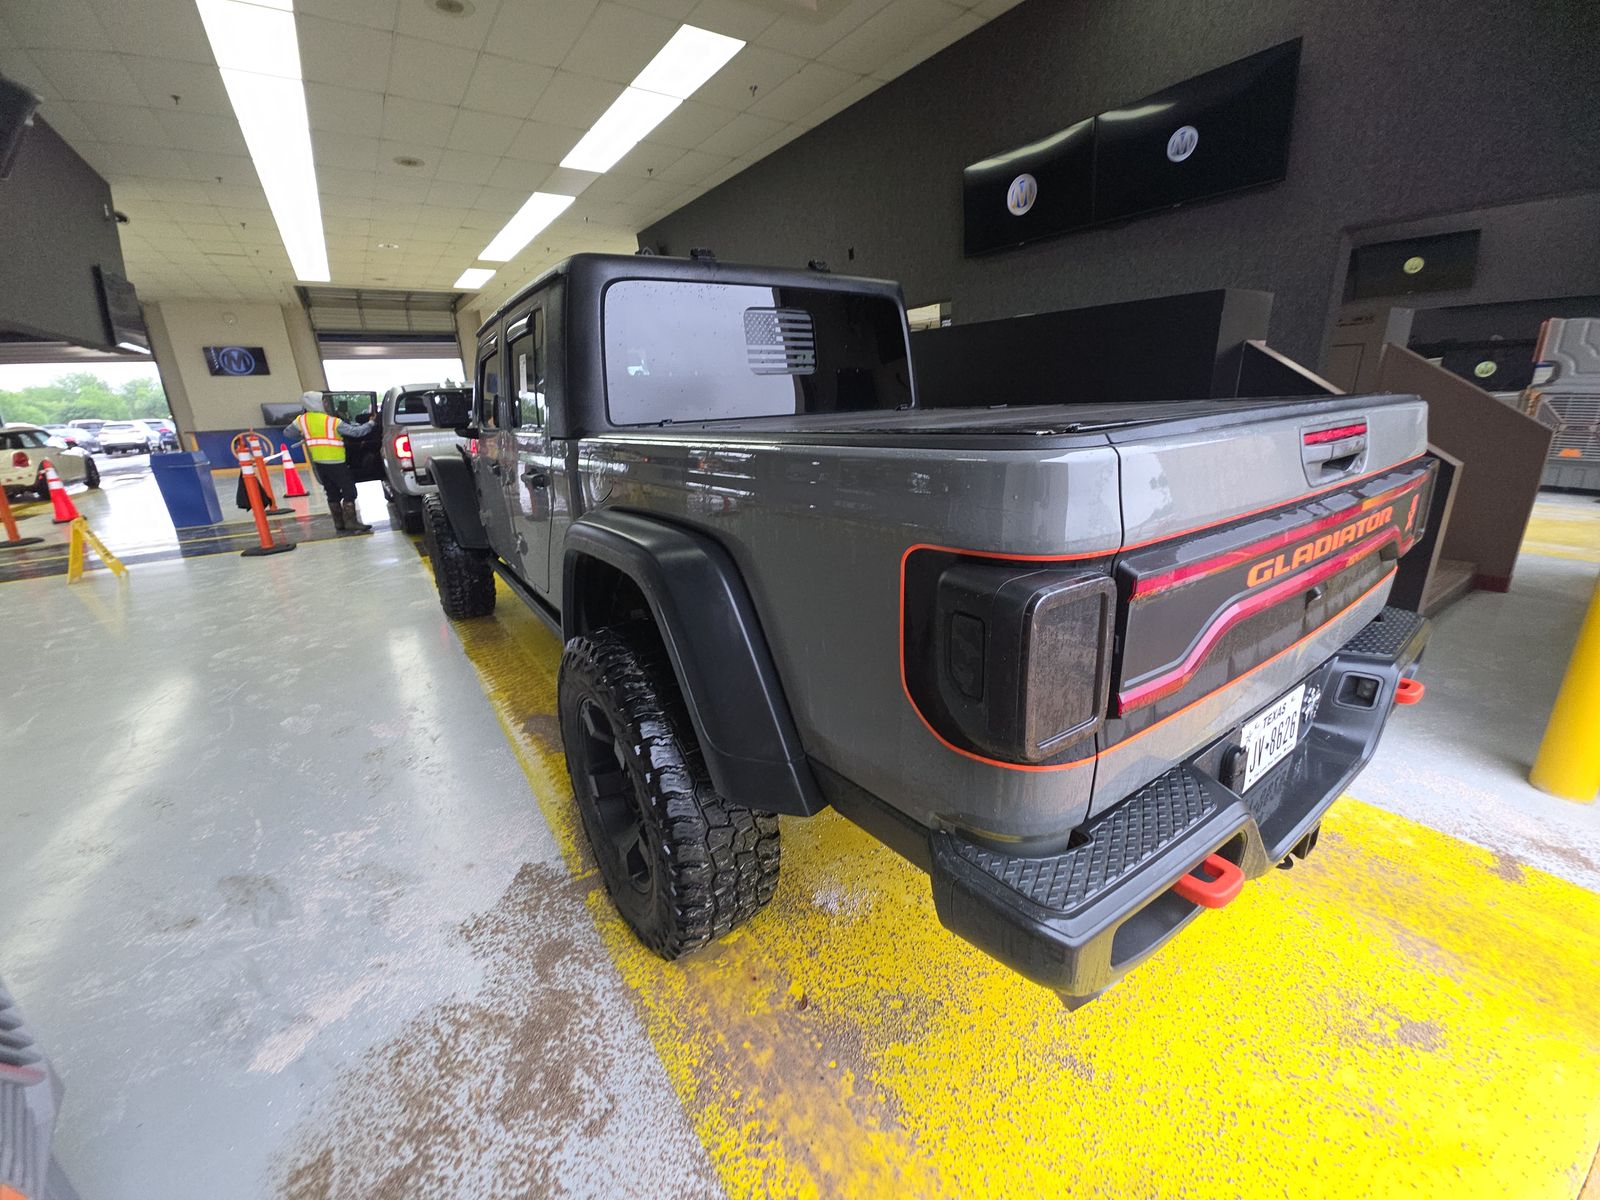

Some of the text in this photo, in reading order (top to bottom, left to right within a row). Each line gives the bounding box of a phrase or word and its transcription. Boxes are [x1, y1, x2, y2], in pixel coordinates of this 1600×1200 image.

[222, 349, 253, 373] M
[1247, 506, 1393, 588] GLADIATOR
[1264, 702, 1286, 728] TEXAS
